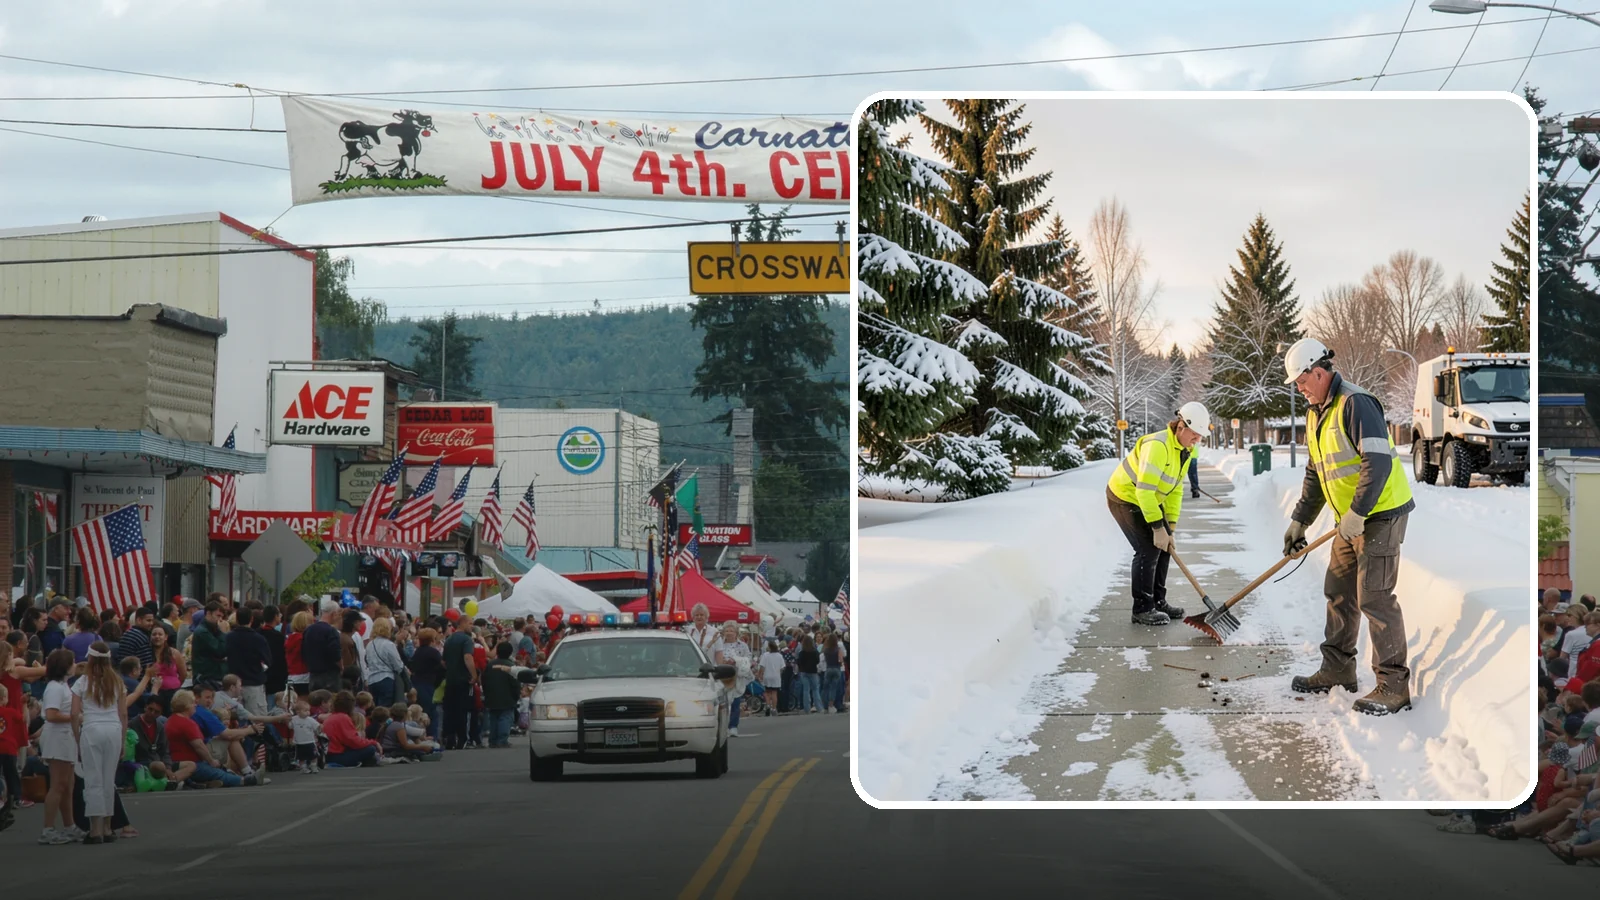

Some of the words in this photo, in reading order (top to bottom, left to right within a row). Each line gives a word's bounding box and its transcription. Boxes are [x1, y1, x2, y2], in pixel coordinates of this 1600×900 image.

[481, 140, 606, 192] JULY
[633, 148, 747, 198] 4th.
[696, 254, 850, 280] CROSSWA
[282, 380, 374, 420] ACE
[405, 410, 453, 422] CEDAR
[461, 410, 485, 421] LOG
[283, 421, 371, 436] Hardware
[416, 427, 477, 447] Coca-Cola
[353, 467, 385, 480] Simpl
[83, 485, 93, 494] St.
[95, 485, 124, 495] Vincent
[126, 486, 136, 495] de
[137, 486, 155, 495] Paul
[688, 526, 742, 535] CRNATION
[699, 535, 730, 543] GLASS
